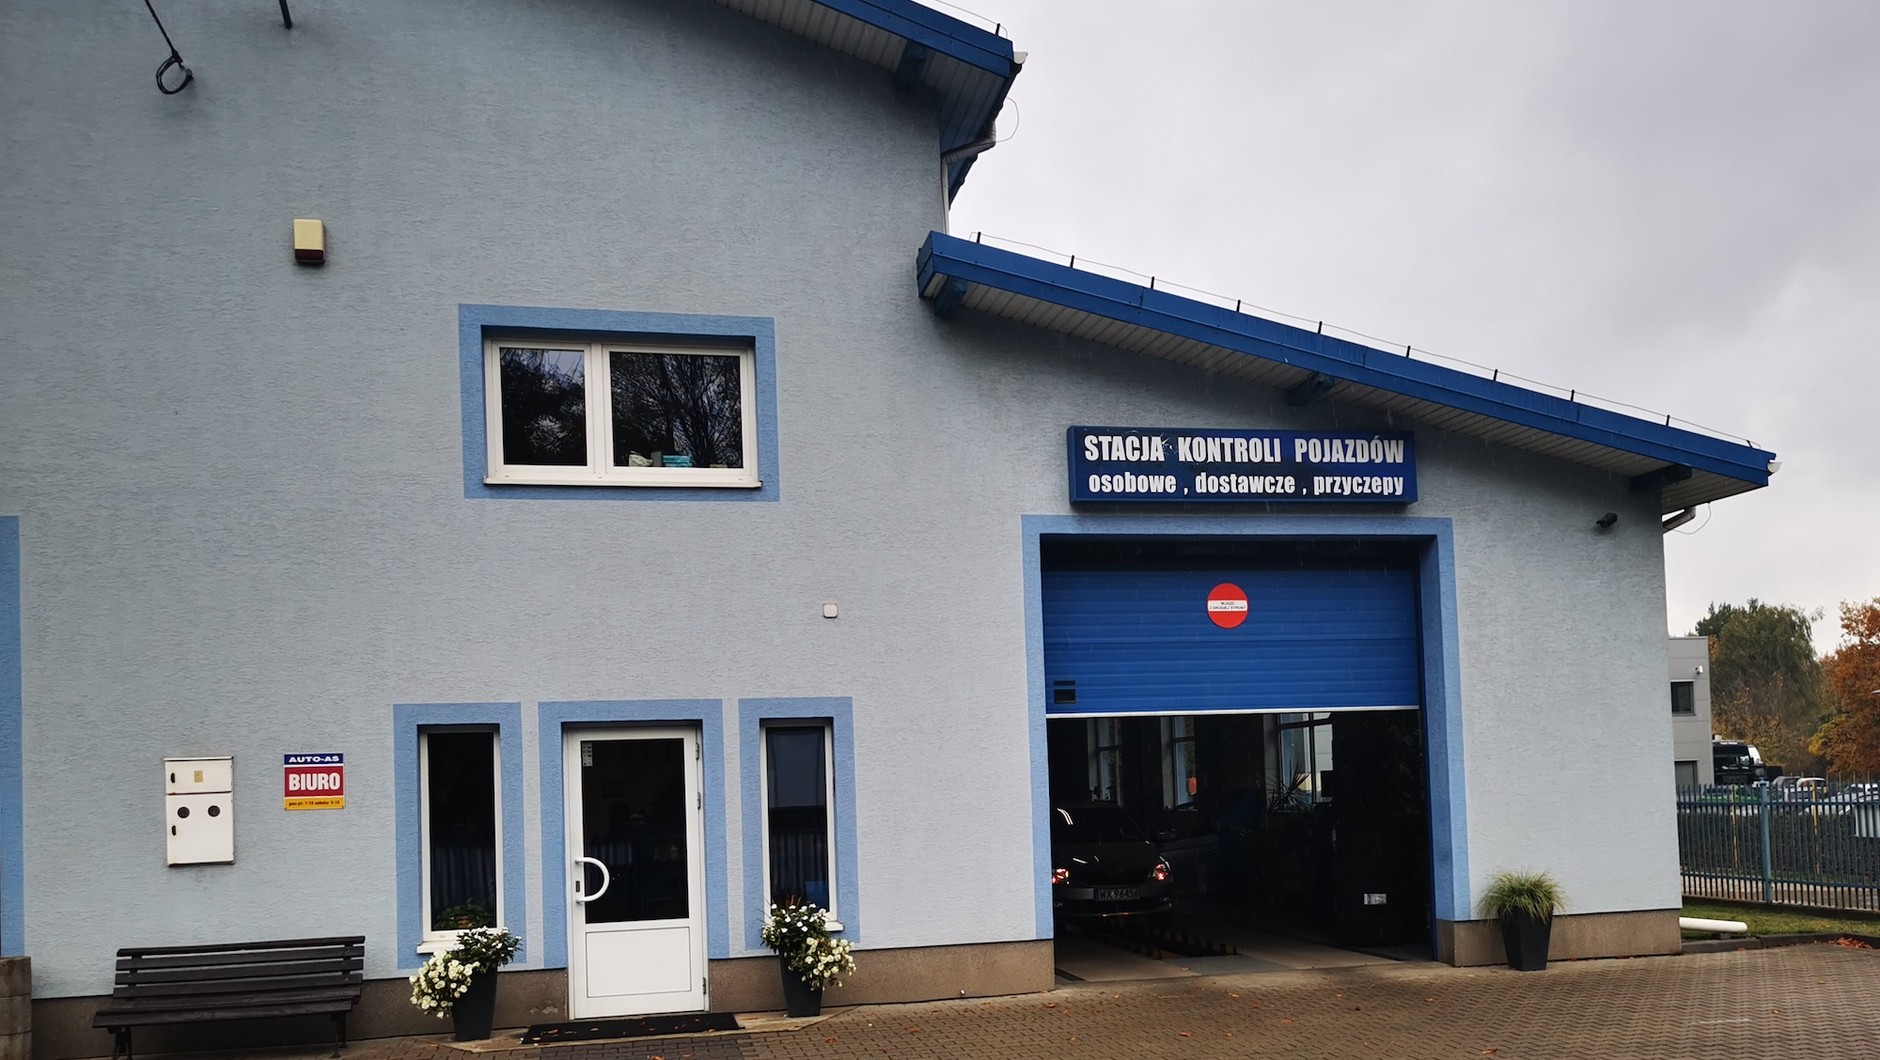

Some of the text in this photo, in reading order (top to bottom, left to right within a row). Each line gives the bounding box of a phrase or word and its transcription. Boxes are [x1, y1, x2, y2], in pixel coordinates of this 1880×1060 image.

[1084, 434, 1404, 464] STACJA KONTROLI POJAZDÓW
[1088, 471, 1177, 494] osobowe
[1195, 472, 1296, 494] dostawcze
[1313, 475, 1404, 496] przyczepy
[288, 755, 340, 763] AUTO-AS
[288, 772, 341, 791] BIURO
